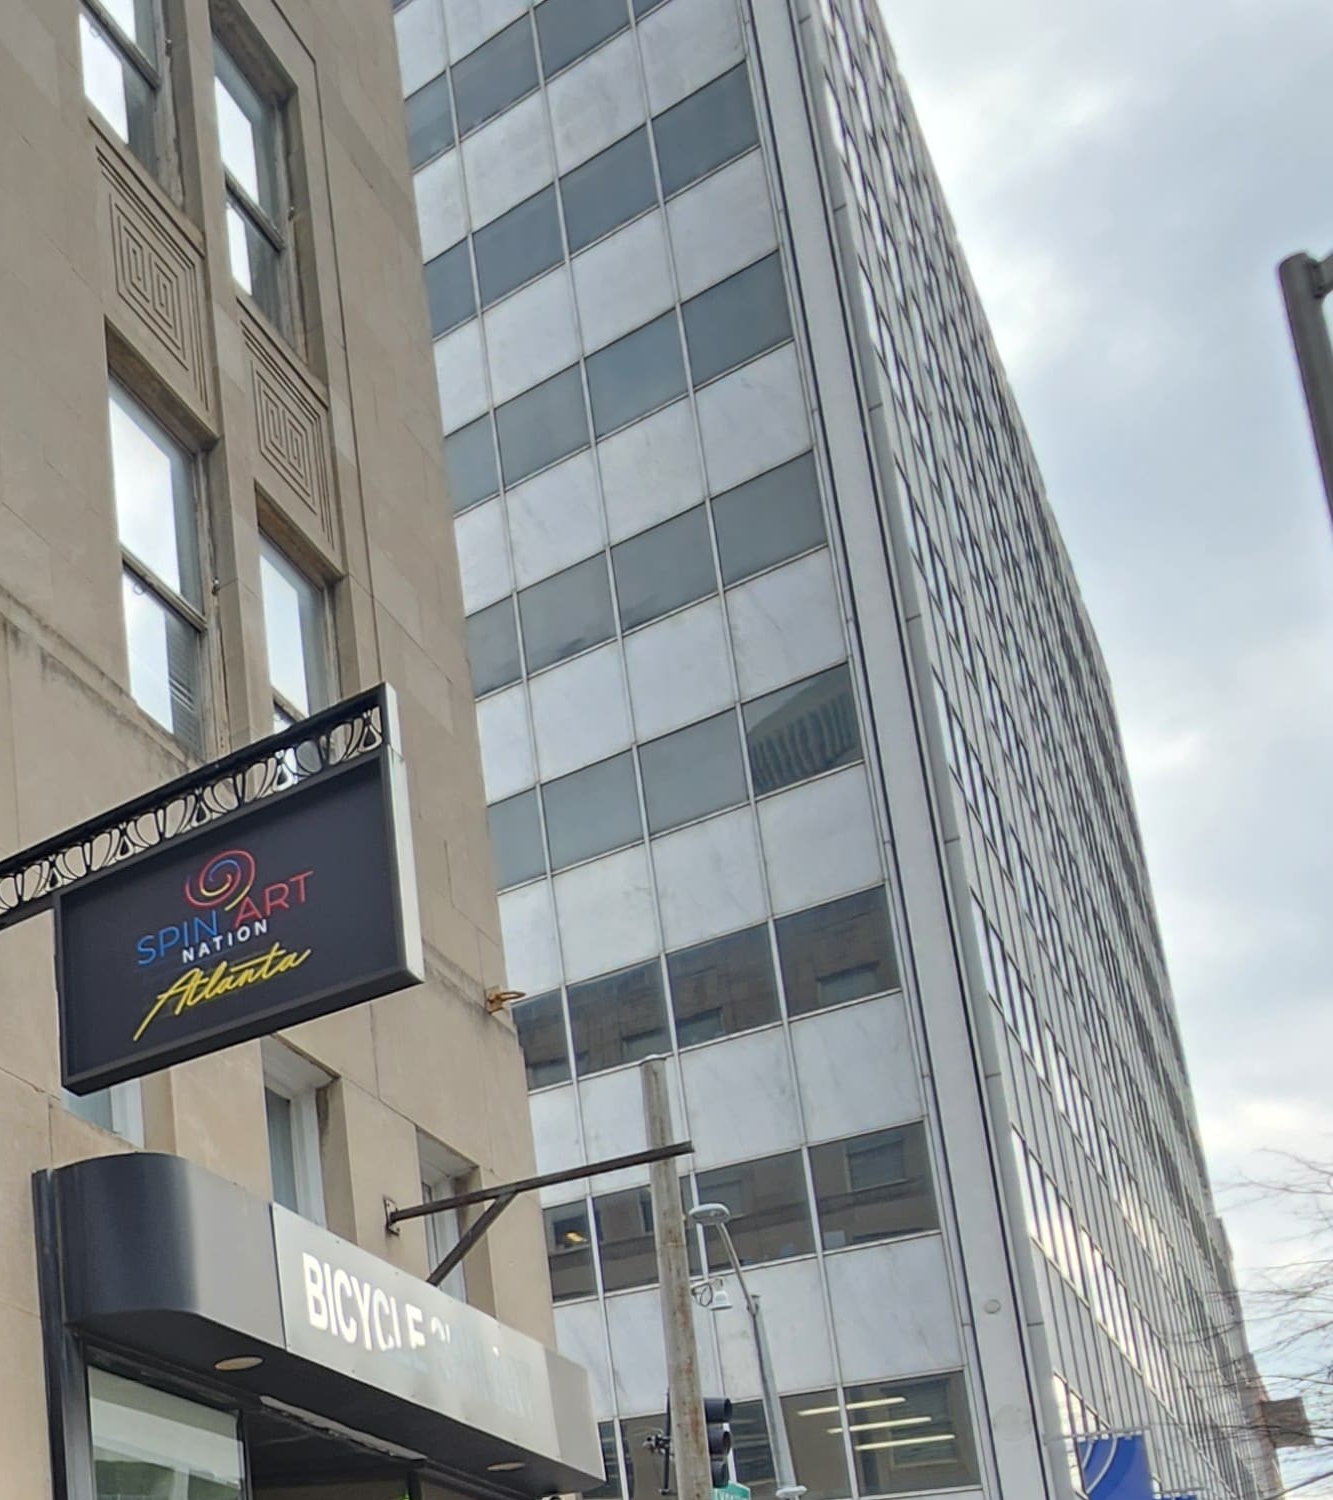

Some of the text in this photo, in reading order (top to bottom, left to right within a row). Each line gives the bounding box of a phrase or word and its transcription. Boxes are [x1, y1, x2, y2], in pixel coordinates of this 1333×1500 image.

[137, 870, 314, 966] SPIN ART
[182, 919, 269, 965] NATION
[133, 941, 312, 1041] Atlanta
